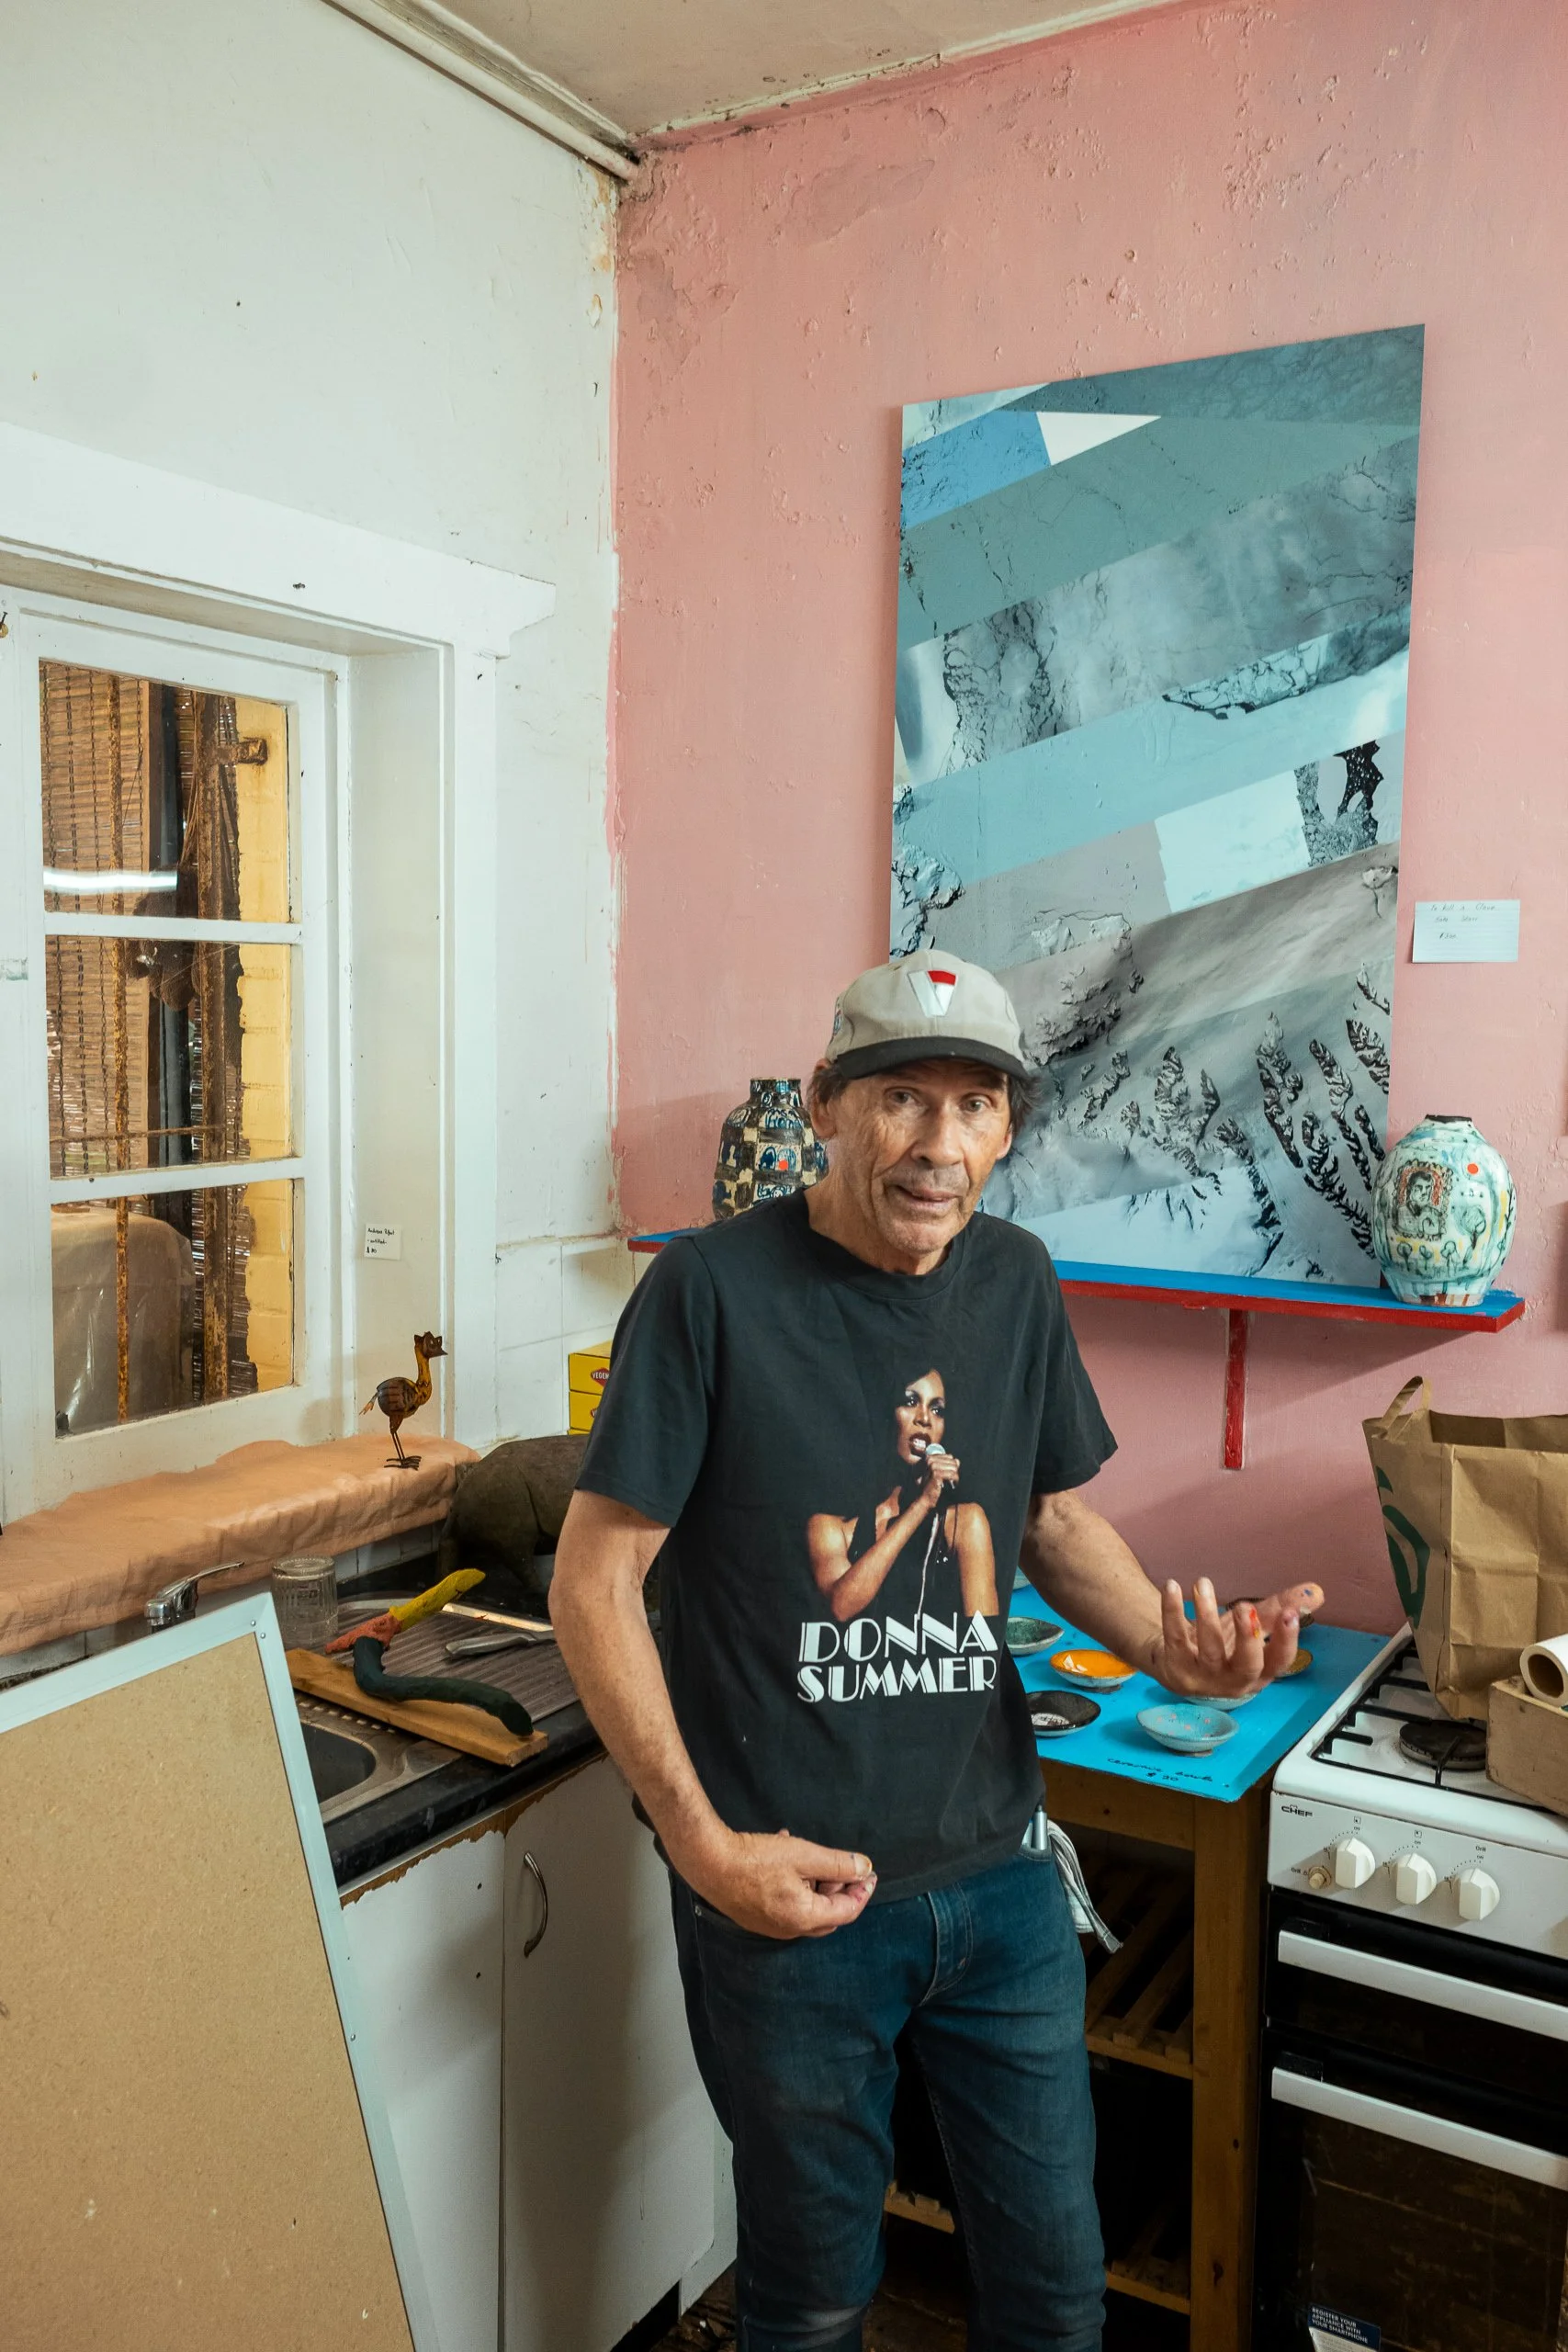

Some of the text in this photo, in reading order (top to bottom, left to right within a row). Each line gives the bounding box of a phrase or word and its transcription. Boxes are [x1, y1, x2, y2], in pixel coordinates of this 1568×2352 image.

[592, 1371, 610, 1380] VEGEM
[798, 1609, 998, 1663] DONNA
[796, 1656, 998, 1703] SUMMER
[1280, 1805, 1314, 1817] CHEF
[1312, 2307, 1357, 2328] REGISTER YOUR
[1312, 2313, 1361, 2335] APPLIANCE WITH
[1312, 2318, 1328, 2329] YOUR
[1328, 2324, 1369, 2345] SMARTPHONE
